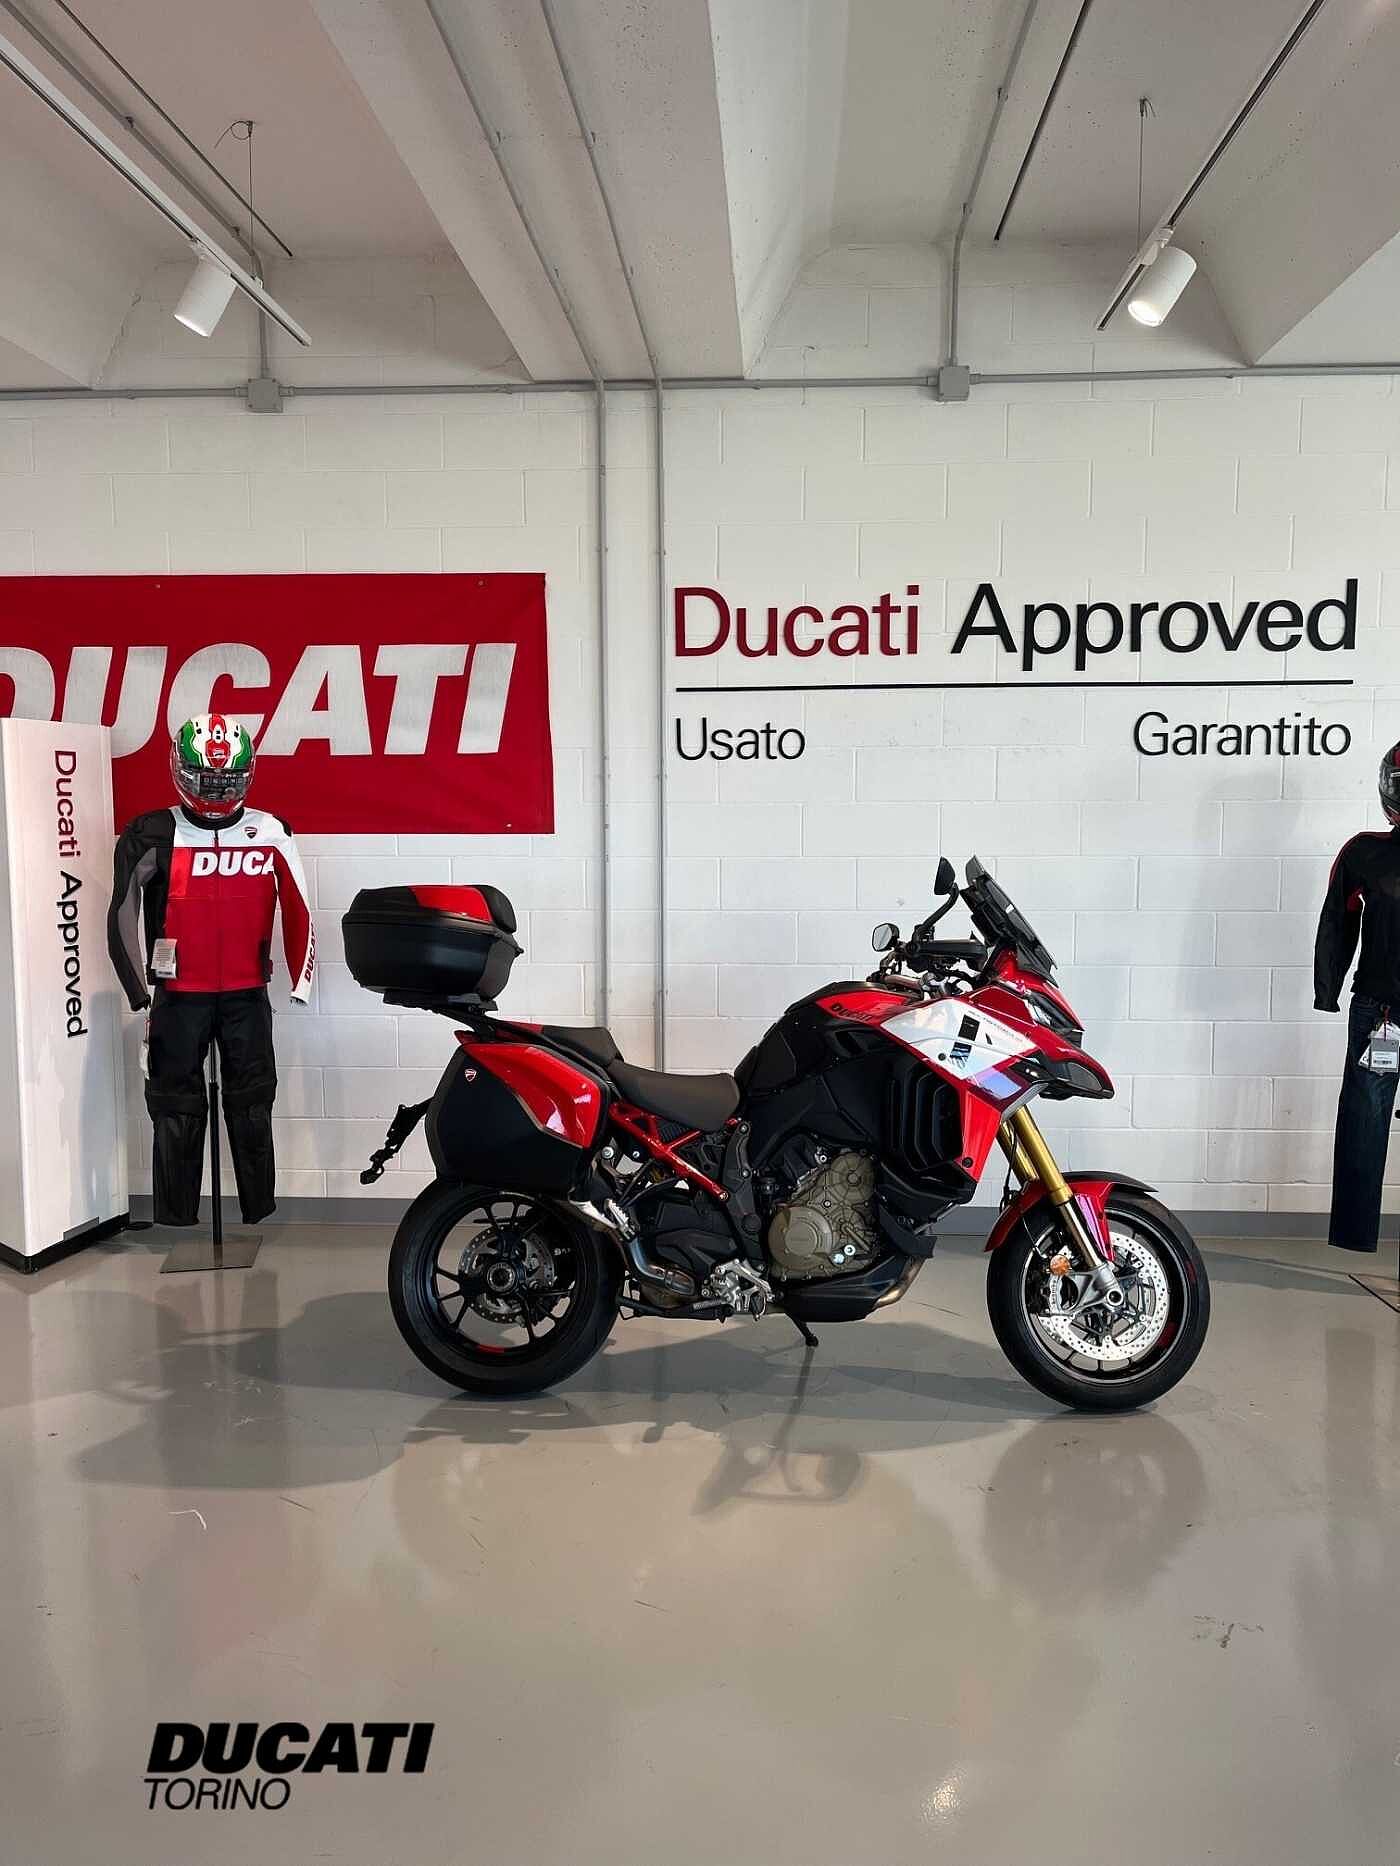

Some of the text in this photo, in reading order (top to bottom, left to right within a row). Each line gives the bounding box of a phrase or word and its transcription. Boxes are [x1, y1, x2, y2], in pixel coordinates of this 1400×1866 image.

[675, 578, 1359, 672] Ducati Approved
[675, 711, 1352, 761] Usato Garantito
[54, 750, 88, 1038] Ducati Approved
